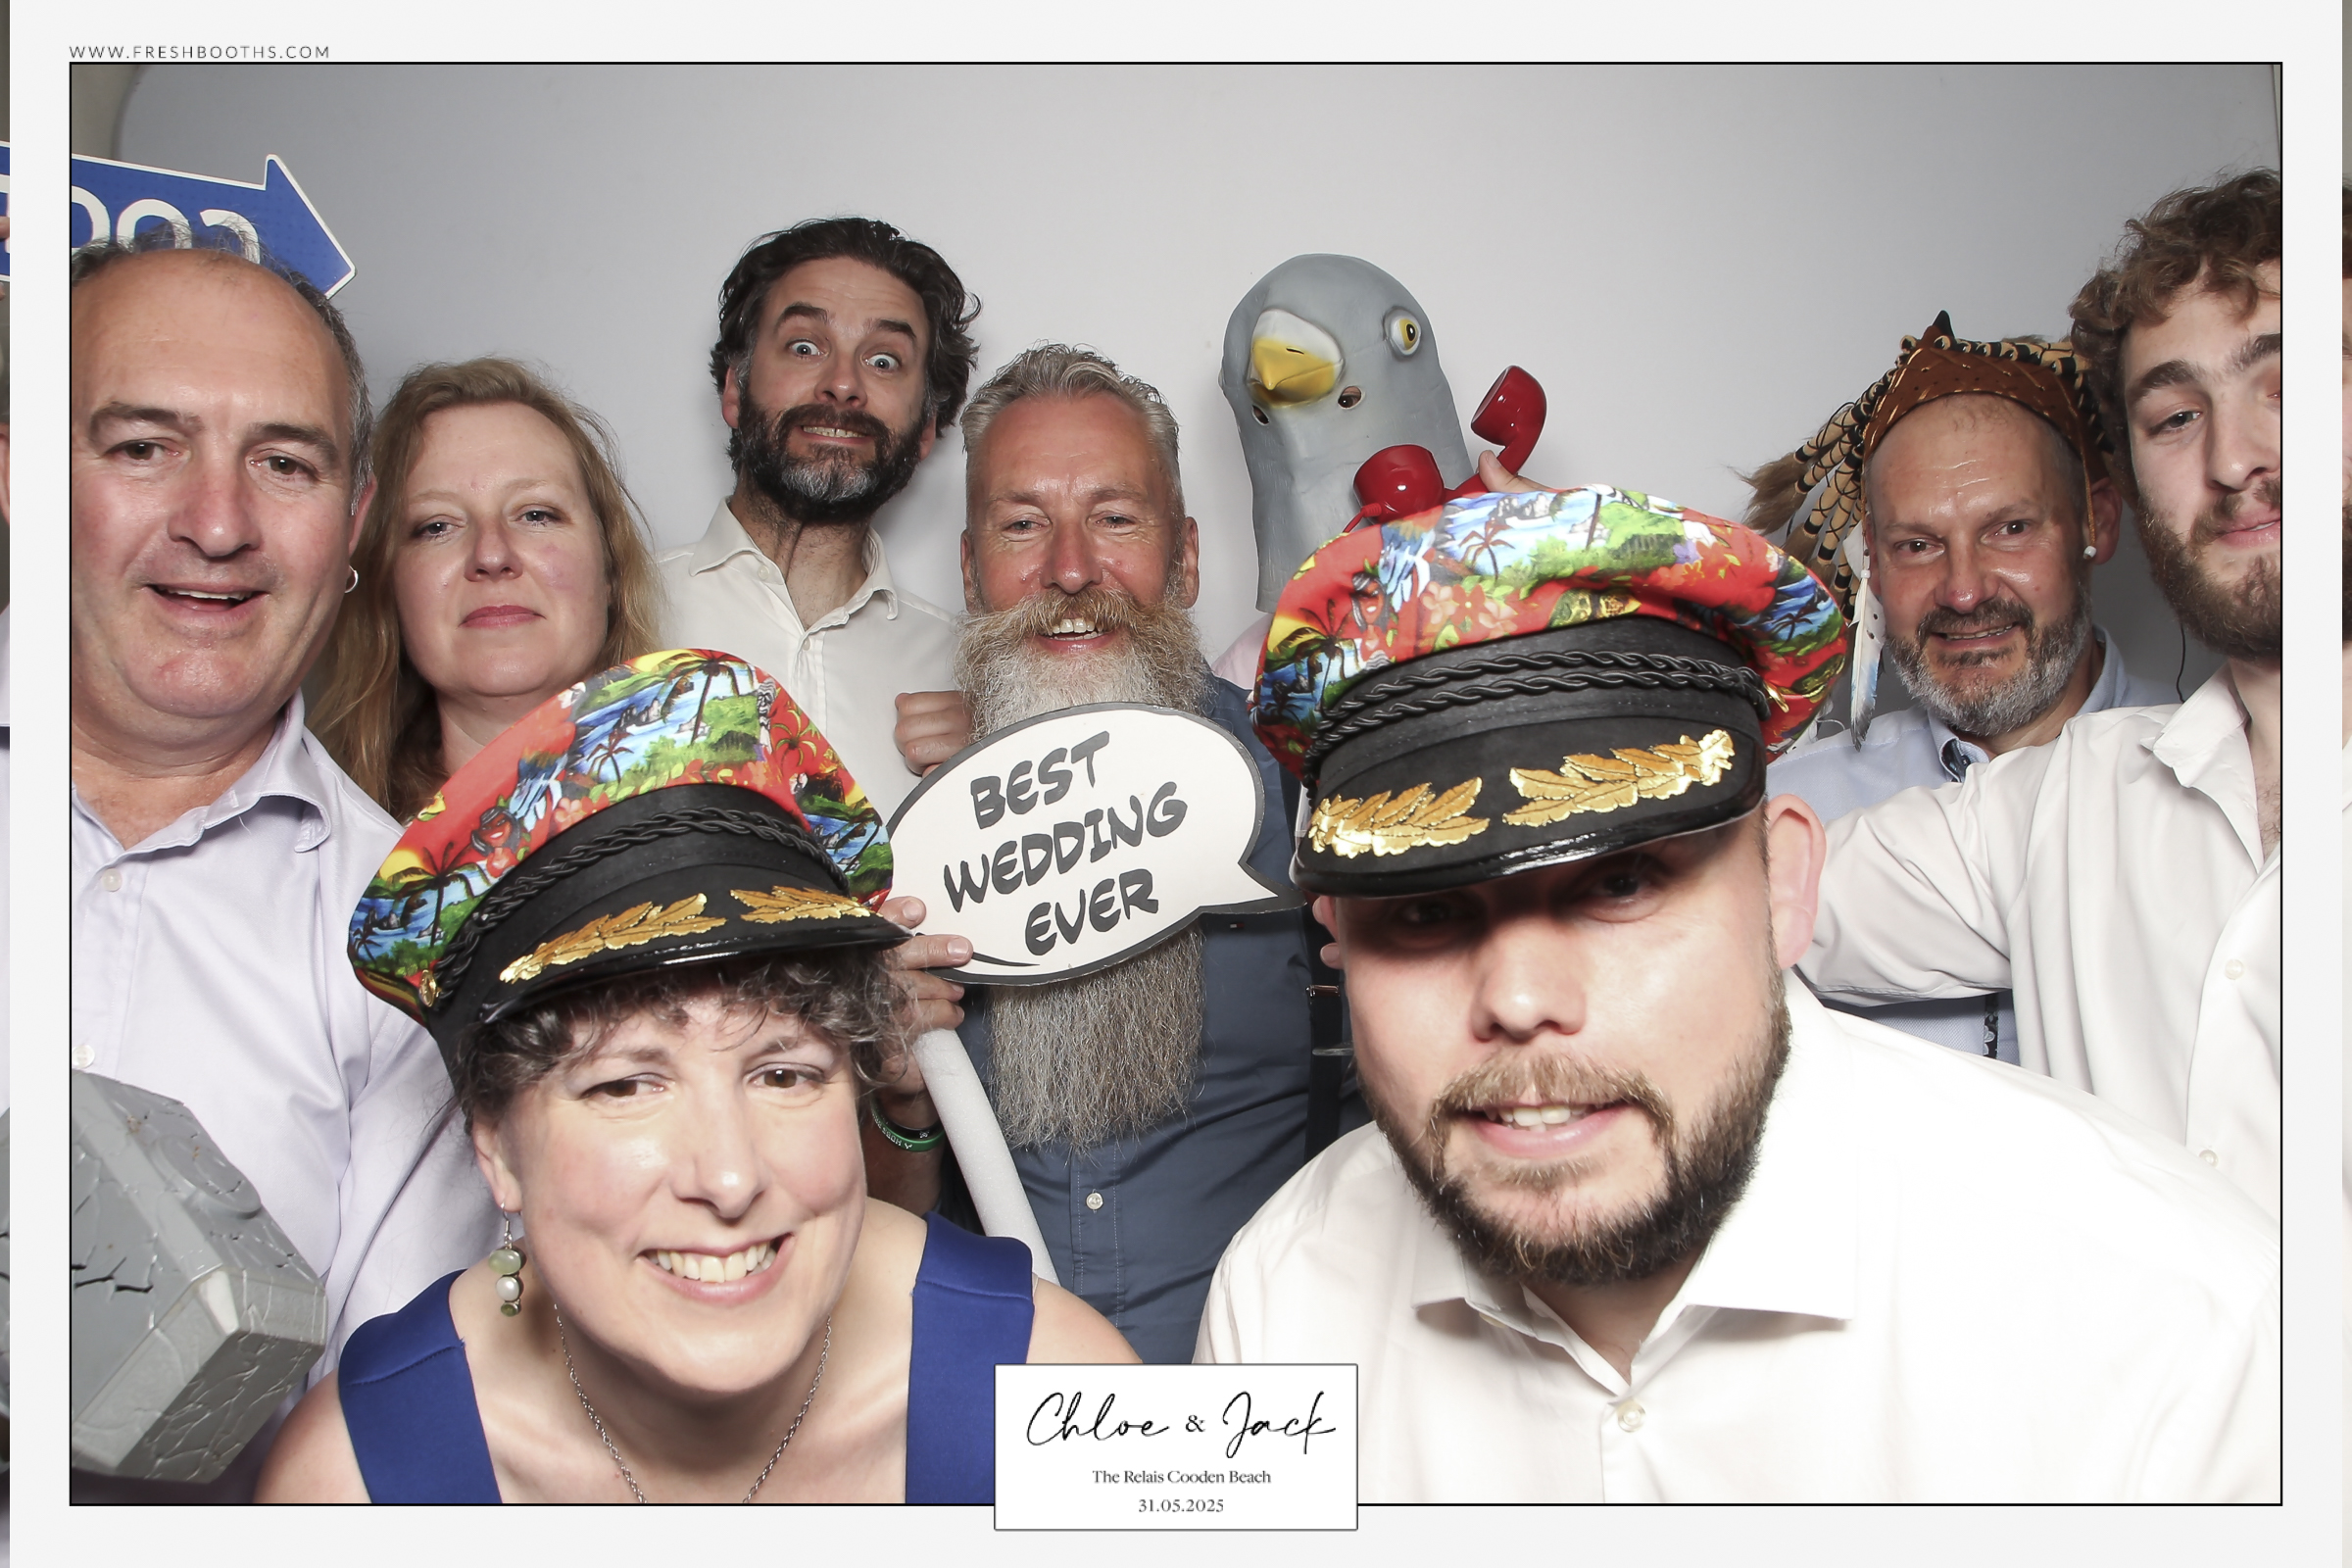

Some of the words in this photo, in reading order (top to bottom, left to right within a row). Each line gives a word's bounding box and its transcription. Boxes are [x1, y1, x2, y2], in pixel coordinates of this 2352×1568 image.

[970, 731, 1109, 829] BEST
[943, 781, 1189, 913] WEDDING
[1025, 868, 1159, 956] EVER
